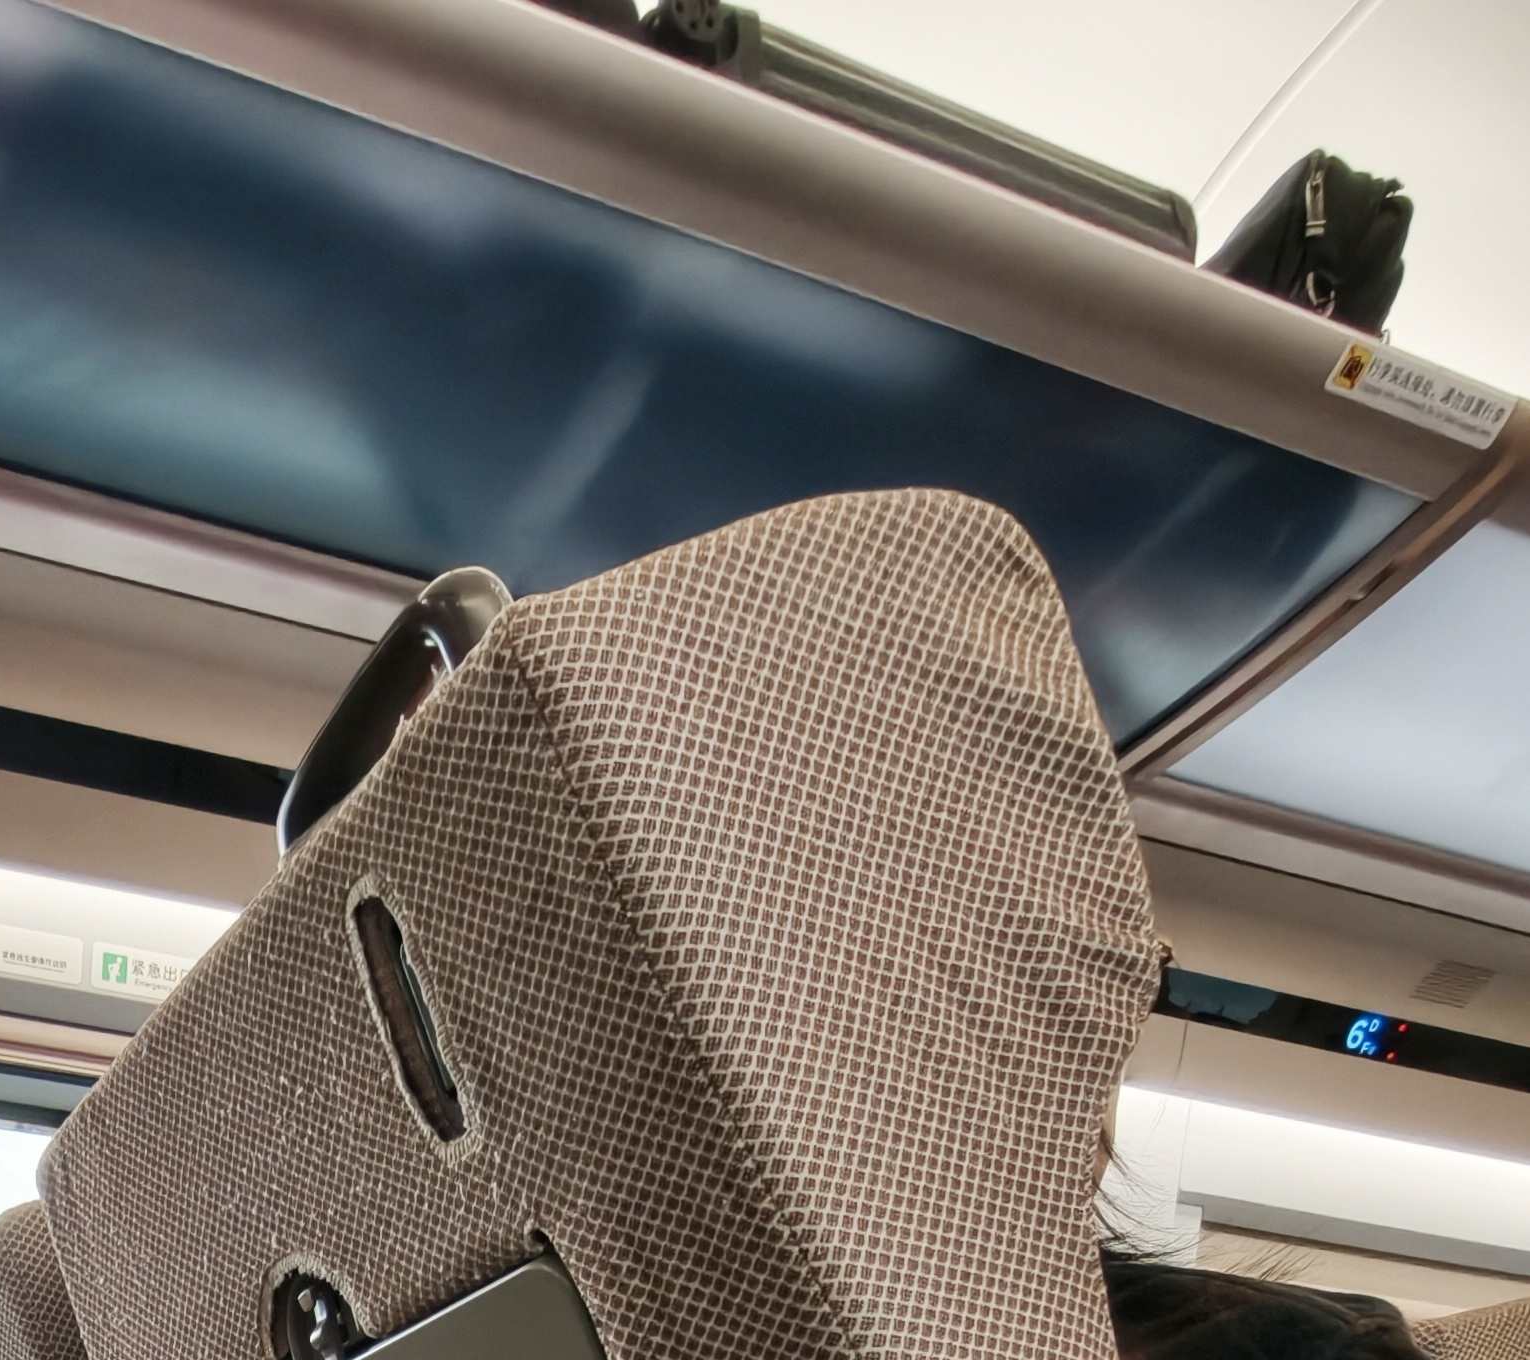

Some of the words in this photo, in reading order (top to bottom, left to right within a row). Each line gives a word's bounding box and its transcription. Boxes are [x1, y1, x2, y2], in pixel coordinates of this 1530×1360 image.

[1346, 1020, 1368, 1049] 6
[1368, 1019, 1380, 1032] D
[1360, 1042, 1370, 1055] F
